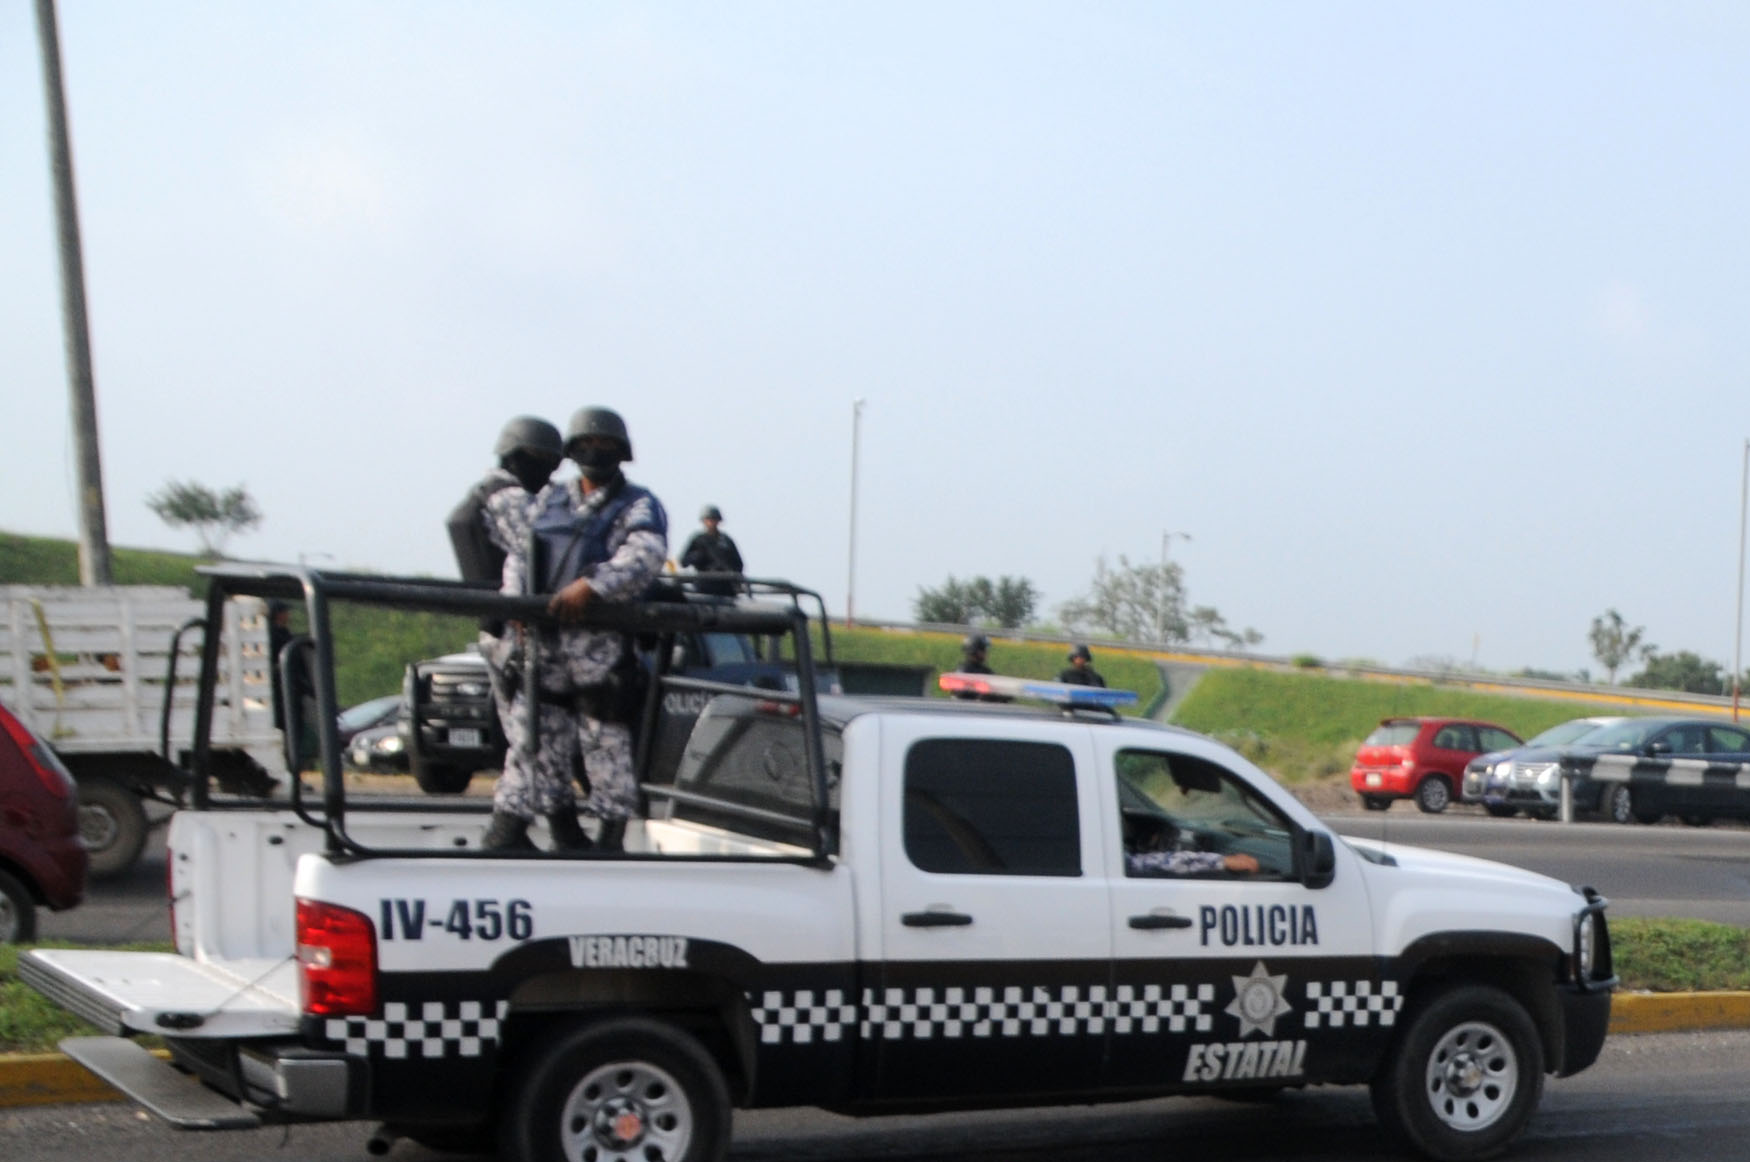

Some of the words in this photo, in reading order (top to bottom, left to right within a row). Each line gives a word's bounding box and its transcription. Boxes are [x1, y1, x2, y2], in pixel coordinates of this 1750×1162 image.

[381, 899, 534, 941] IV-456
[1201, 904, 1319, 946] POLICIA
[568, 936, 689, 968] VERACRUZ
[1182, 1040, 1307, 1081] ESTATAL
